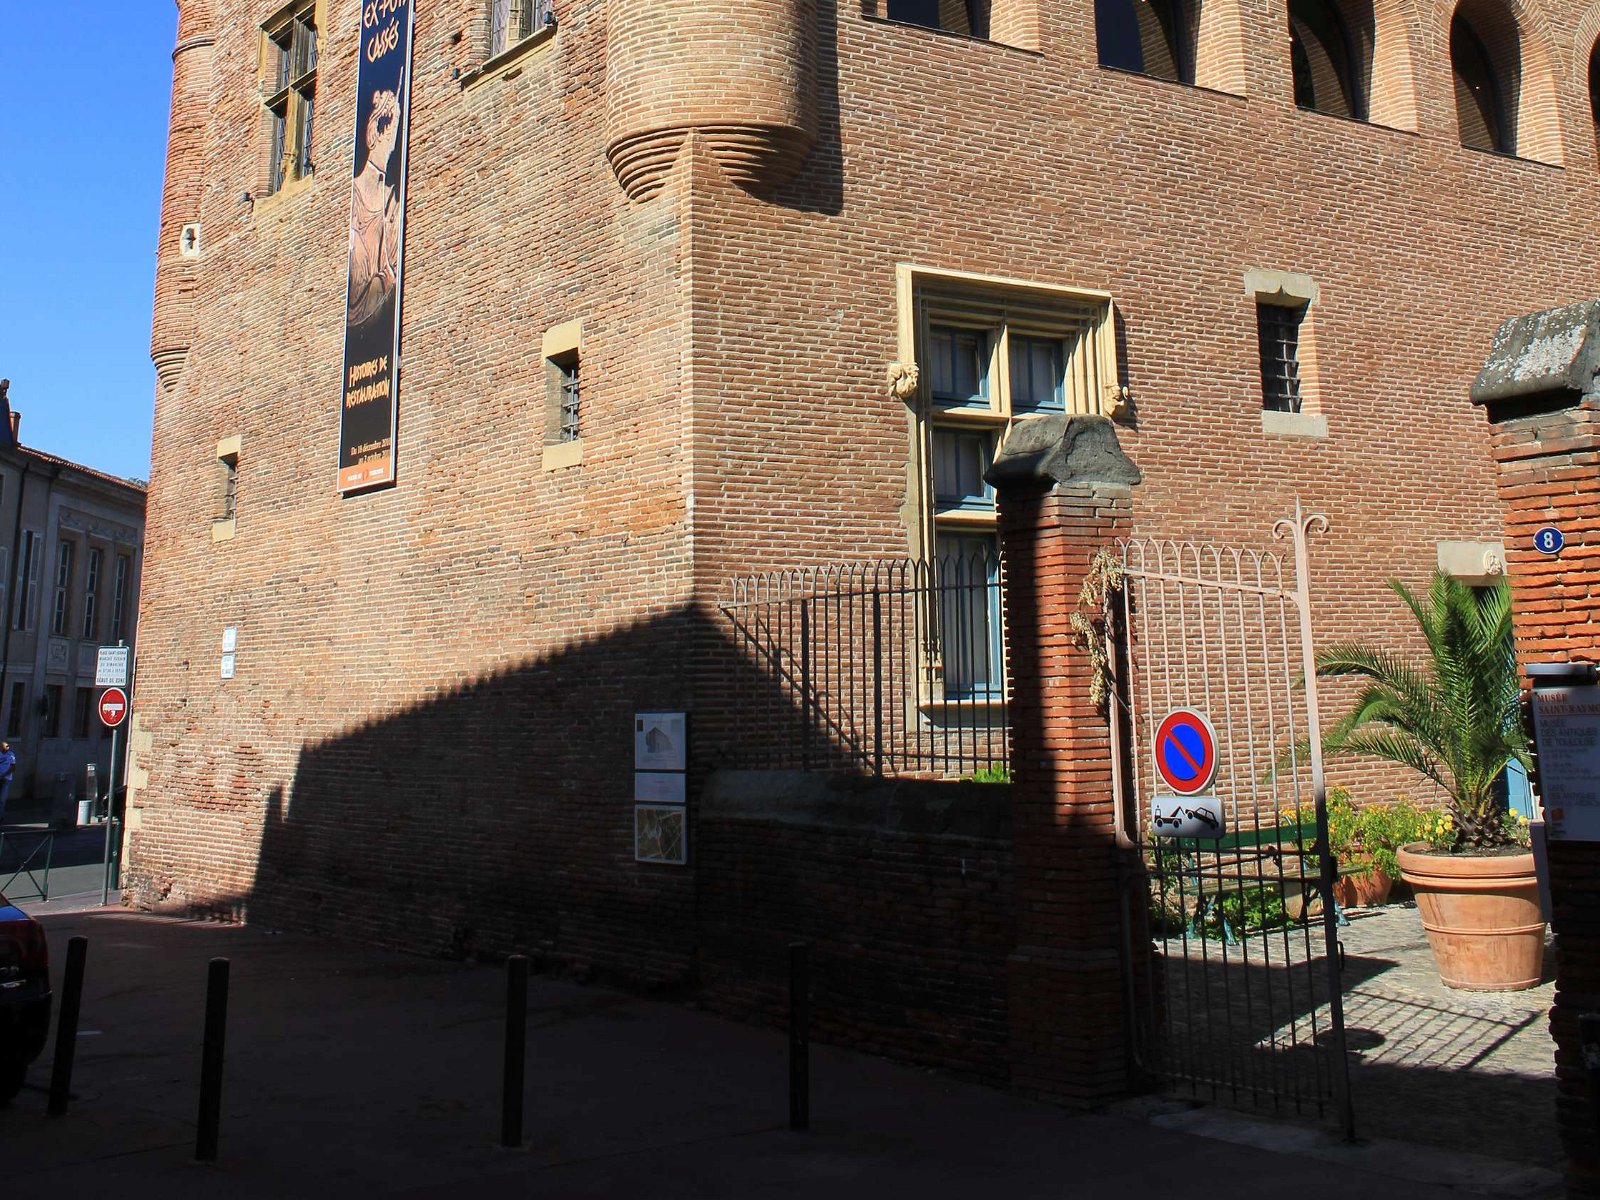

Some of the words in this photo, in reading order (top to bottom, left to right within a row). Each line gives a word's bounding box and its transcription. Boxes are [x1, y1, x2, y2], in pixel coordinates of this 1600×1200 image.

[367, 17, 400, 63] CASSÉS
[1543, 531, 1554, 549] 8
[1537, 692, 1567, 703] MUSÉE
